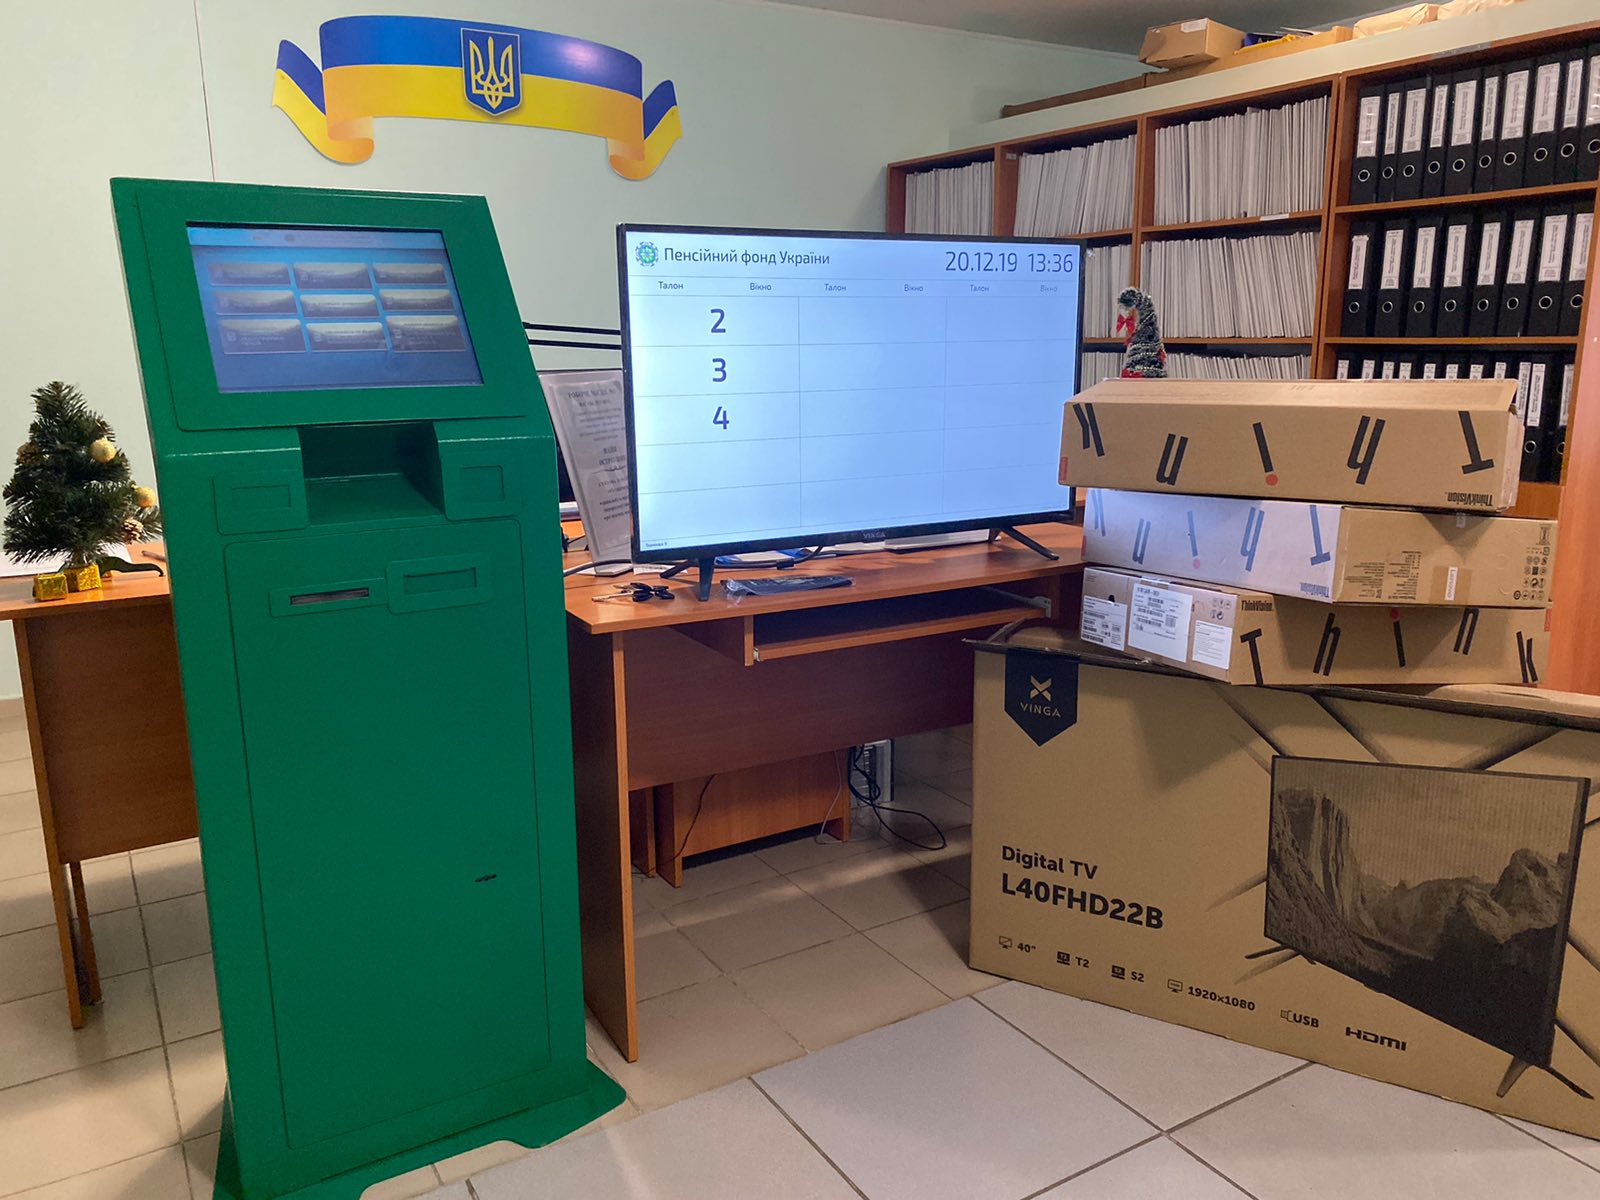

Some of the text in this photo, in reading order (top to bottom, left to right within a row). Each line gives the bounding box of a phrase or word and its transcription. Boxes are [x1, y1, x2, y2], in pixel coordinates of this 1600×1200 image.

[664, 248, 830, 267] Пенсійний фонд України
[945, 251, 1074, 273] 20.12.19 13:36
[658, 281, 684, 290] Талон
[749, 282, 772, 291] Вікно
[824, 283, 847, 292] Талон
[904, 284, 924, 292] Вікно
[970, 284, 990, 292] Талон
[710, 308, 726, 333] 2
[712, 357, 727, 382] 3
[712, 406, 730, 430] 4
[1447, 491, 1494, 507] ThinkVision
[1299, 582, 1330, 599] ThinkVision
[1241, 599, 1273, 612] ThinkVision
[1020, 702, 1061, 718] VINGA
[1002, 845, 1098, 879] Digital TV
[1002, 873, 1164, 929] L40FHD22B
[1075, 956, 1089, 968] T2
[1130, 971, 1145, 983] S2
[1188, 986, 1256, 1011] 1920x1080
[1293, 1013, 1320, 1028] USB
[1345, 1026, 1407, 1051] HDMI
